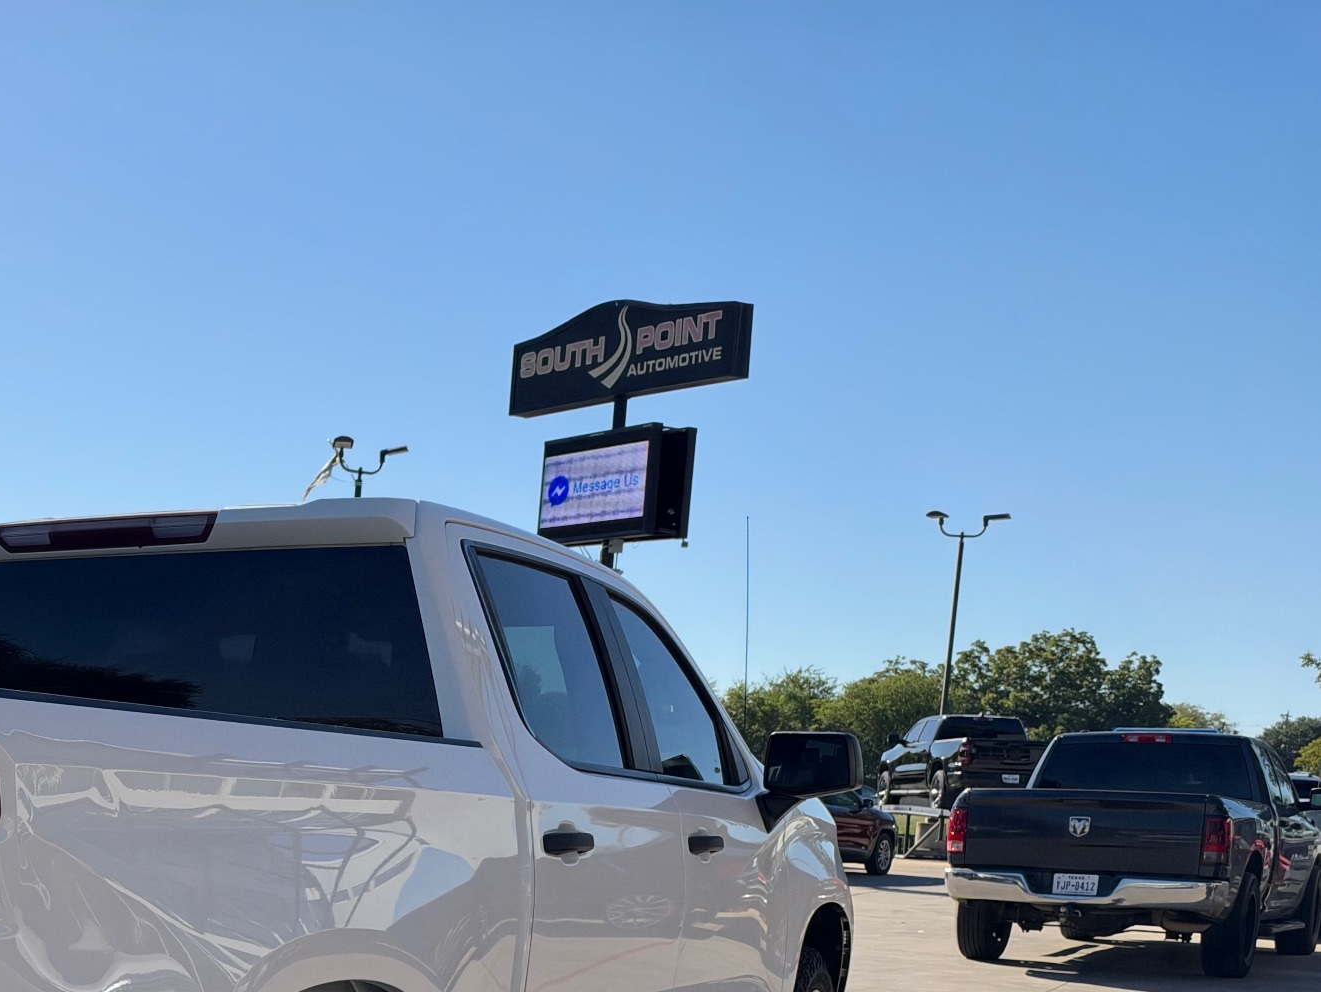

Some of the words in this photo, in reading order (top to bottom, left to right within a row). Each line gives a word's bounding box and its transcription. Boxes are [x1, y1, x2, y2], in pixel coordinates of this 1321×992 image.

[520, 336, 606, 379] SOUTH
[635, 310, 723, 355] POINT
[627, 346, 723, 378] AUTOMOTIVE
[573, 478, 621, 493] Message
[624, 472, 639, 487] Us
